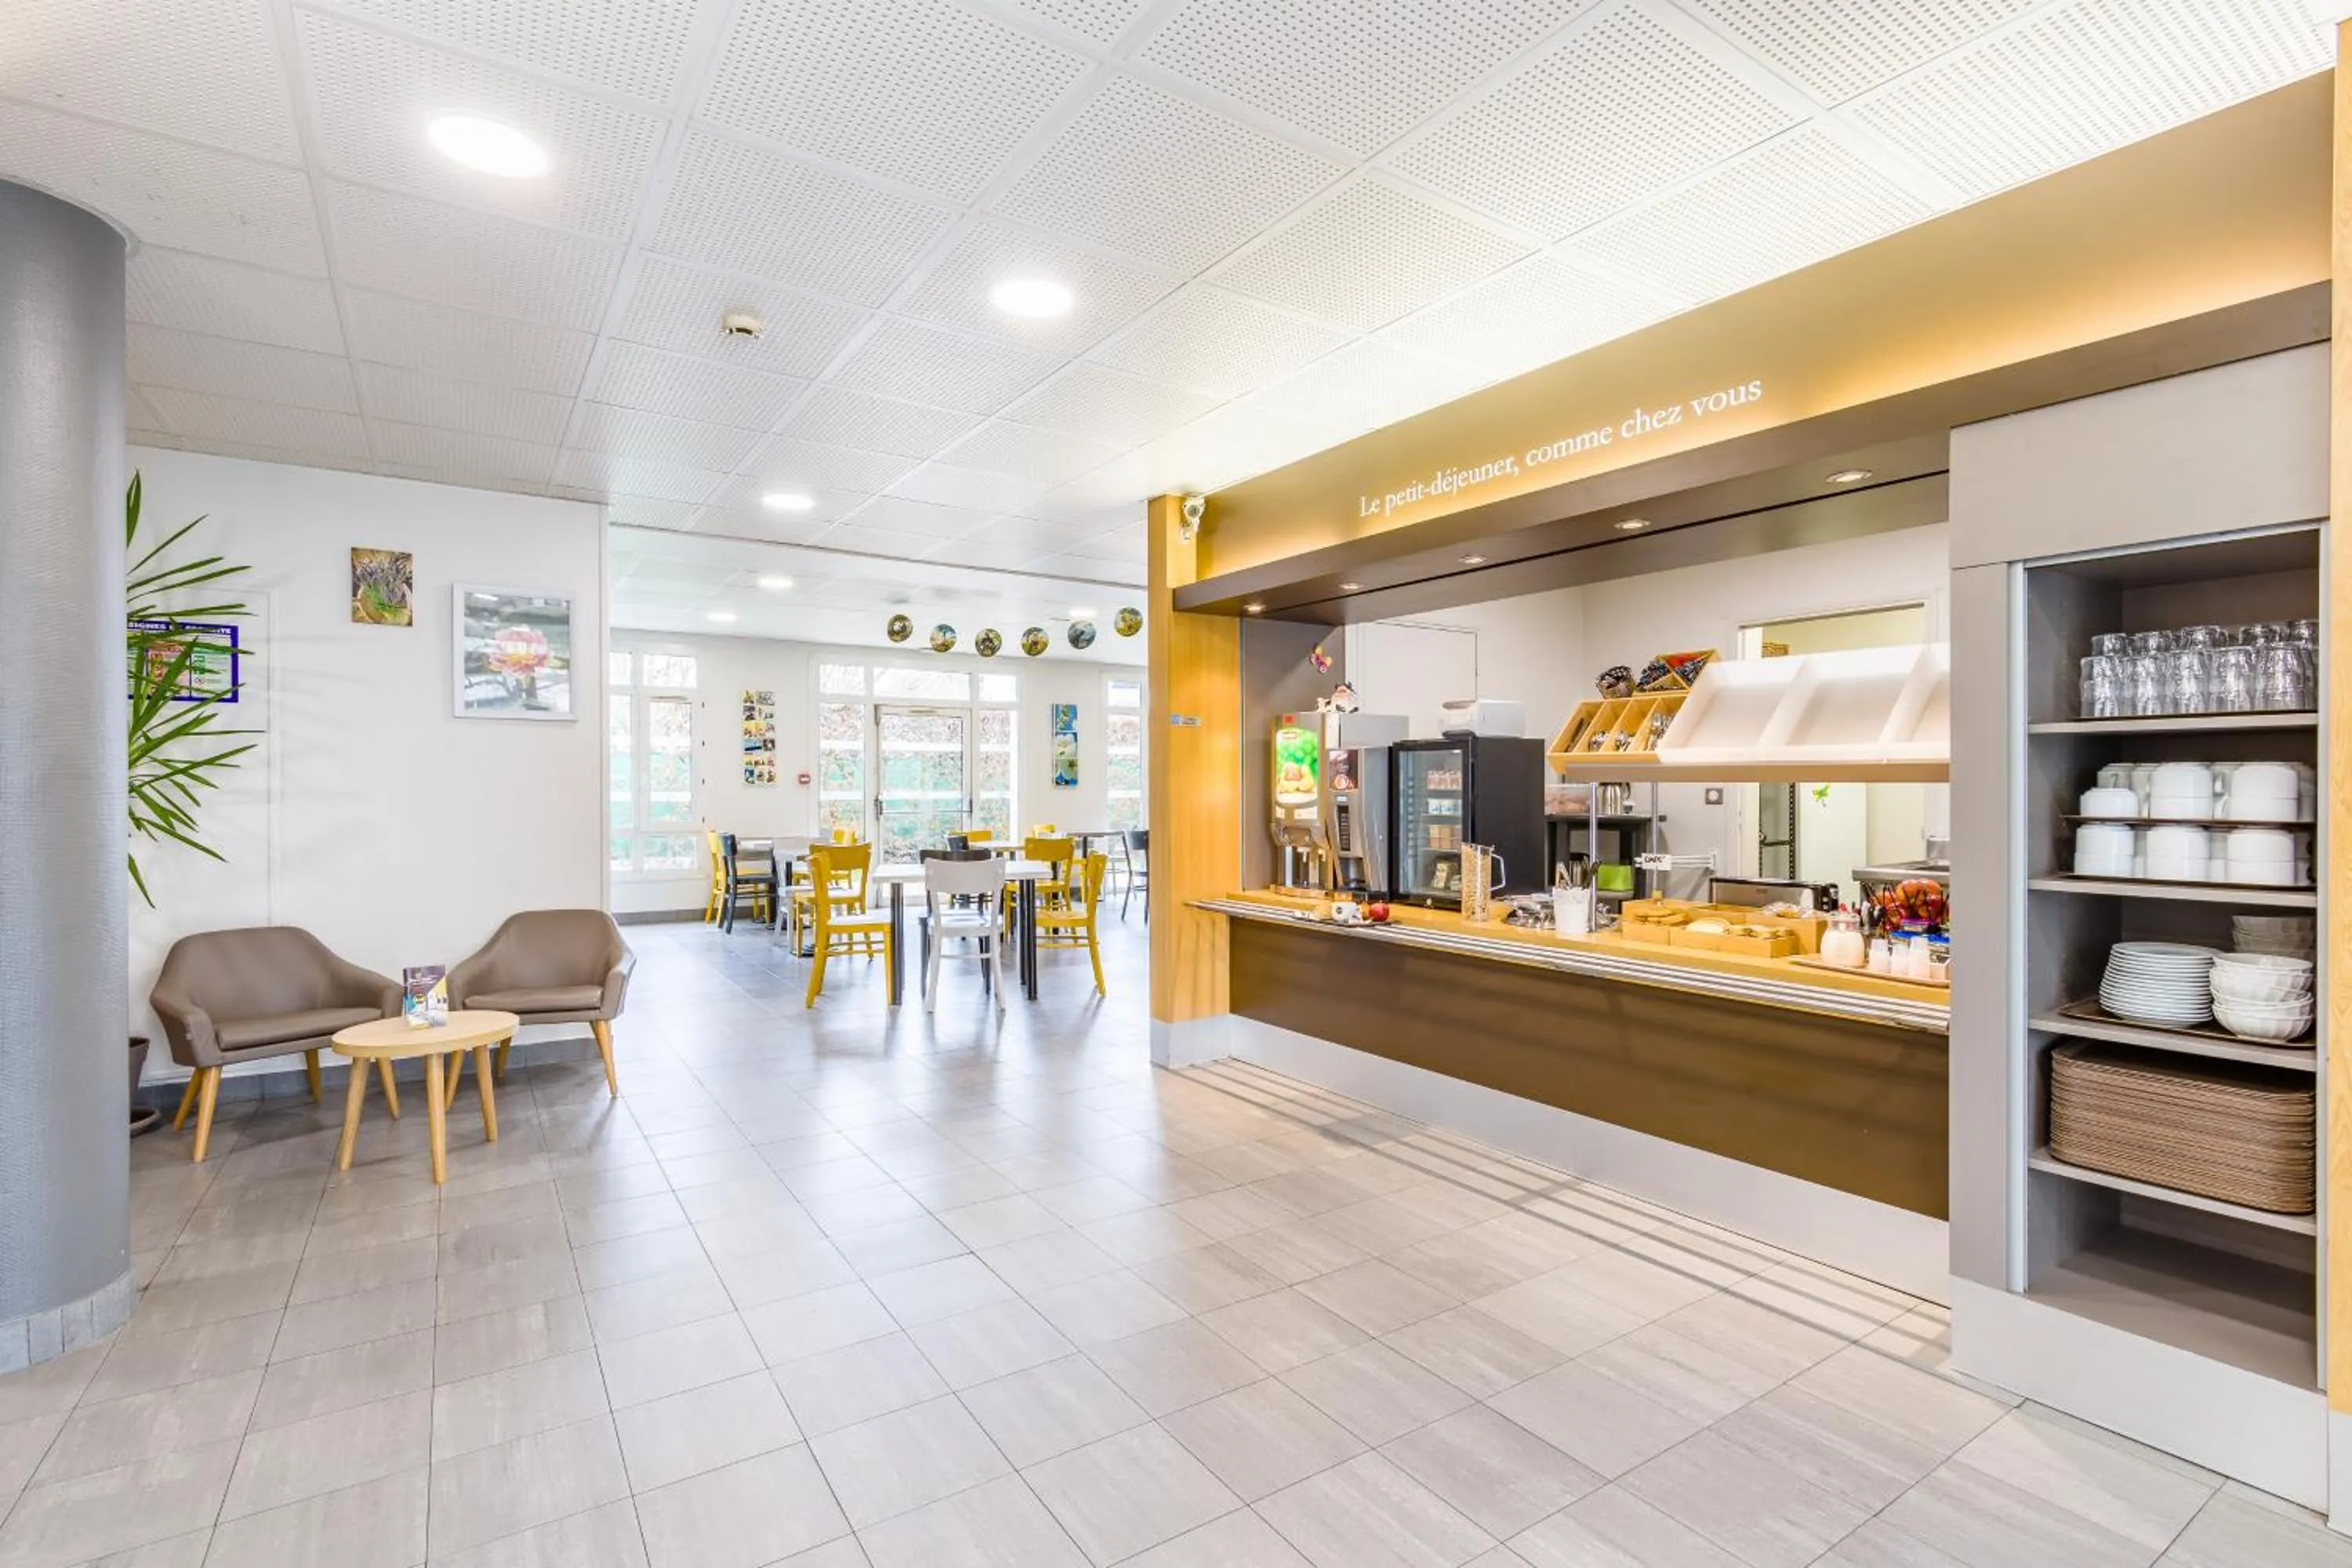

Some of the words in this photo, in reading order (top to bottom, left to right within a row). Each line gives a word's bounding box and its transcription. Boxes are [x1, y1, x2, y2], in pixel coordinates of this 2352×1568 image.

[1359, 496, 1381, 517] Le
[1385, 456, 1519, 517] petit-déjeuner,
[1526, 426, 1613, 466] comme
[1621, 408, 1682, 438] chez
[1690, 379, 1762, 416] vous
